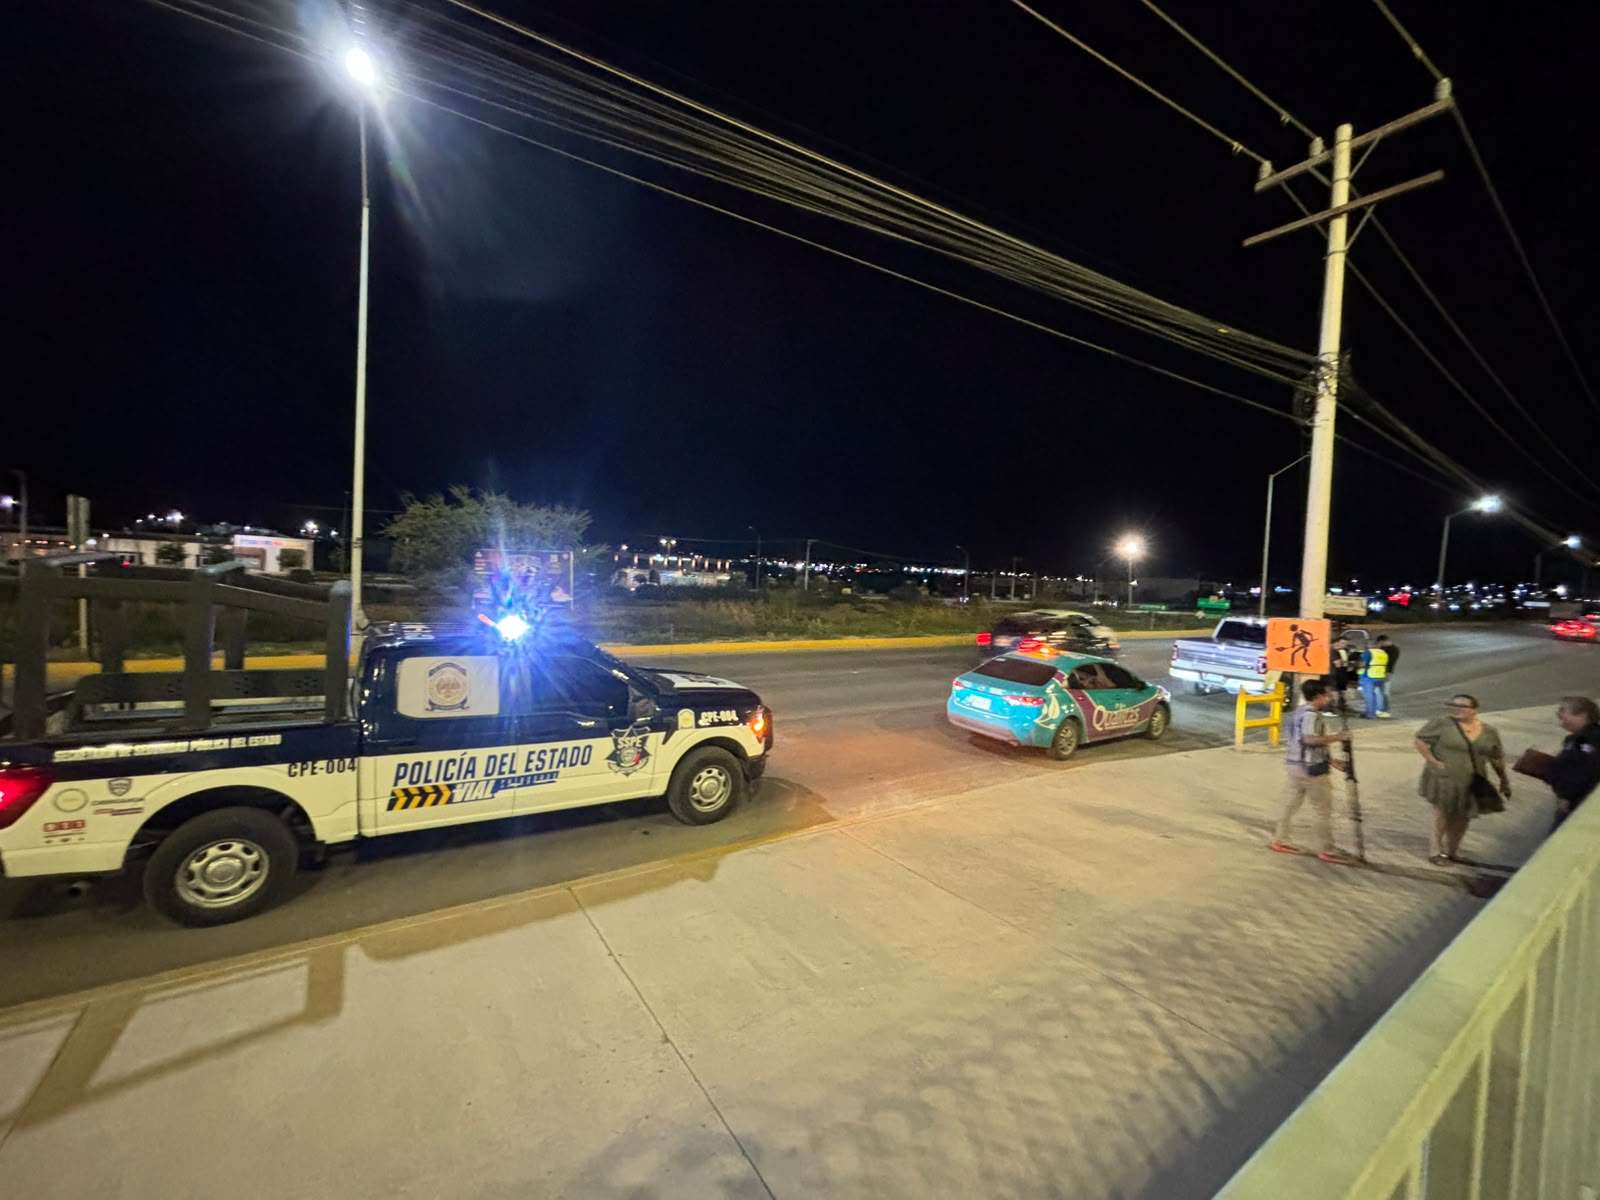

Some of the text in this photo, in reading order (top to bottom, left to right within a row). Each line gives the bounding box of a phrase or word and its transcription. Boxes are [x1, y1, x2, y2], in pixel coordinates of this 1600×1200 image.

[249, 734, 282, 746] ESTADO
[617, 736, 643, 749] SSPE
[288, 757, 357, 777] CPE-004
[392, 752, 477, 787] POLICÍA
[484, 752, 517, 778] DEL
[524, 744, 593, 773] ESTADO
[452, 778, 496, 803] VIAL
